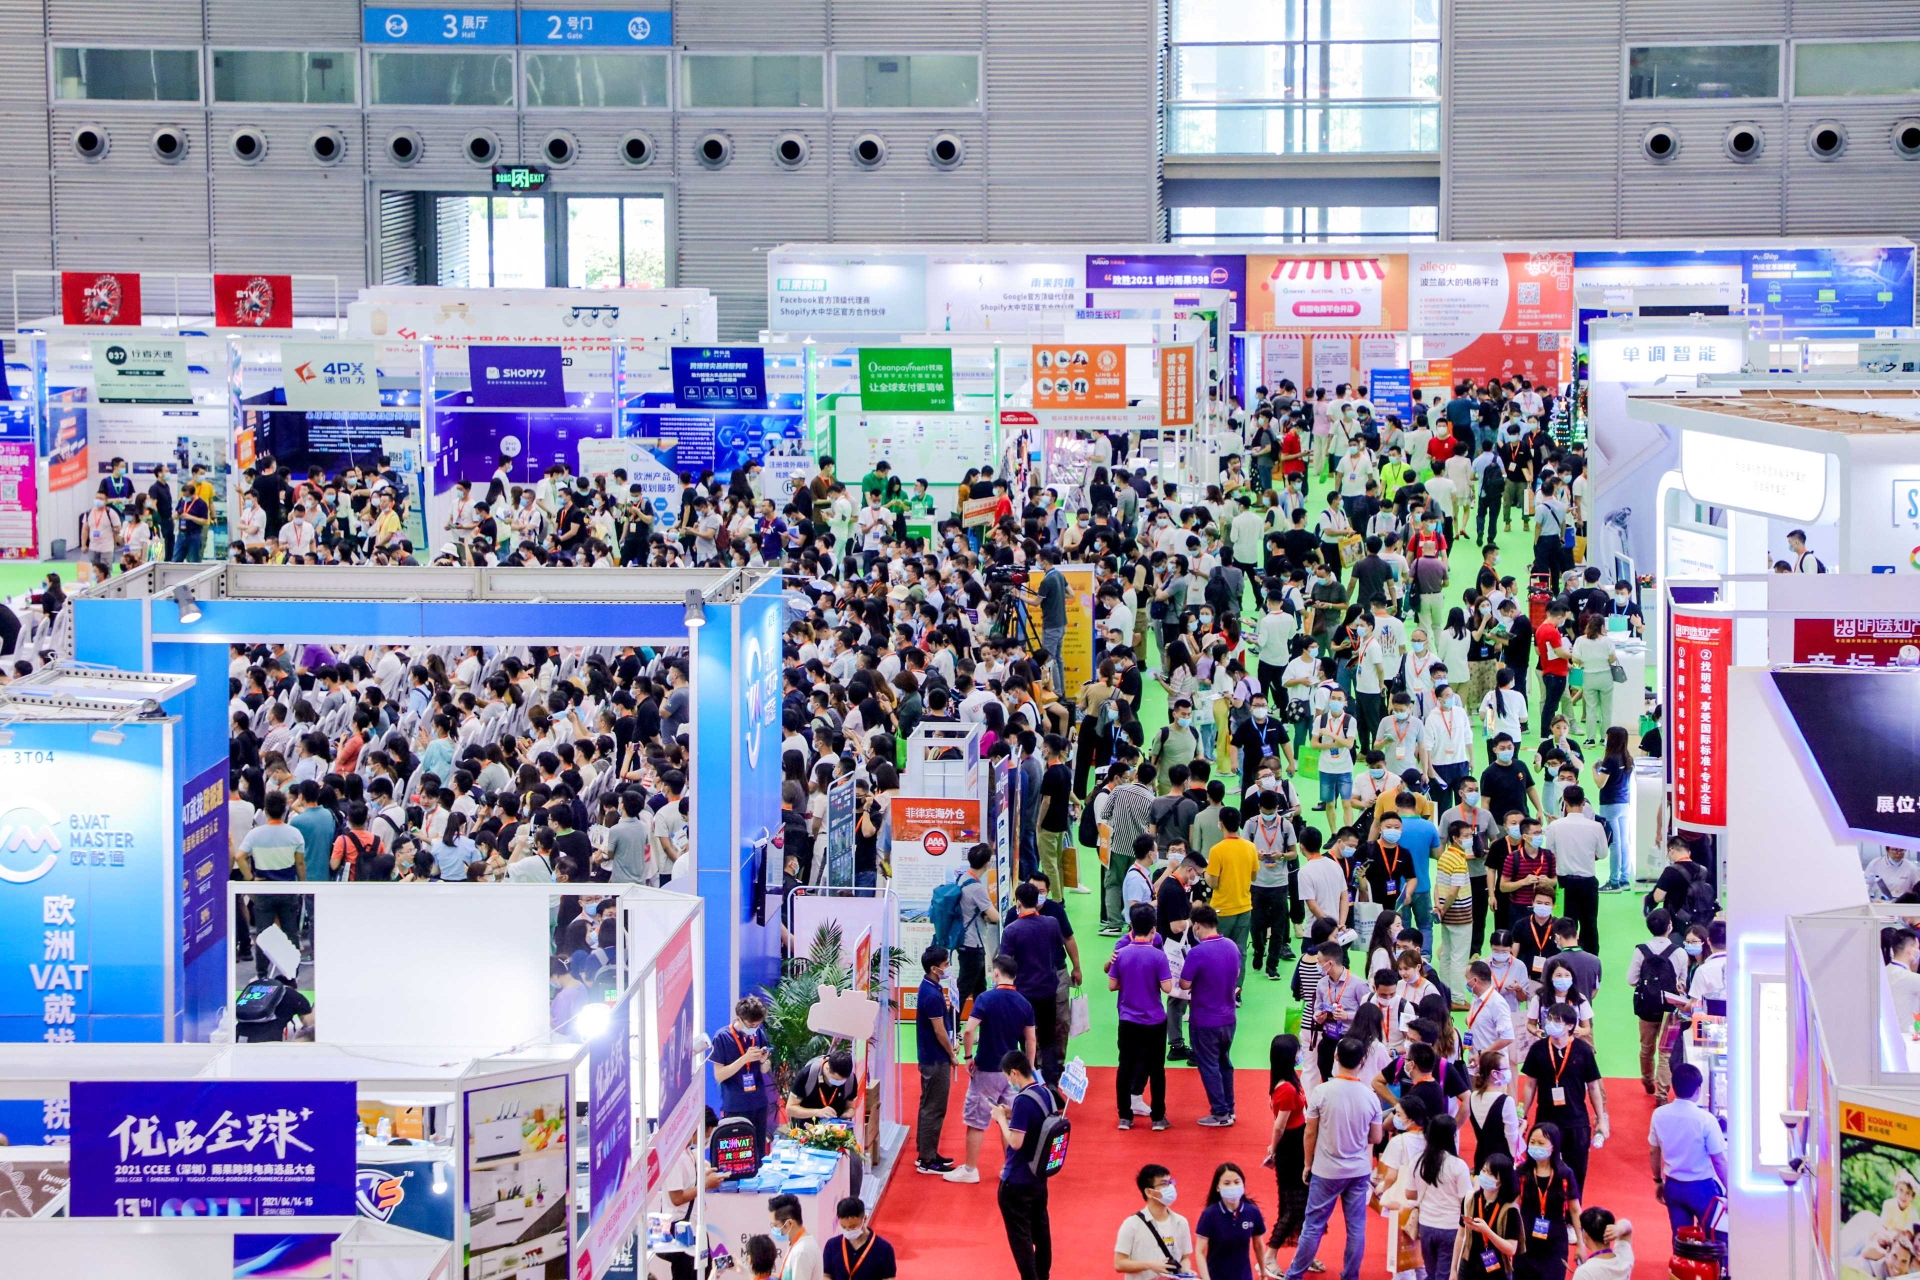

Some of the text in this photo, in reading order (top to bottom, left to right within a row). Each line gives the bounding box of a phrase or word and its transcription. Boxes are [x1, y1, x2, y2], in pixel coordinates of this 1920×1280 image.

[443, 14, 488, 38] 3 展厅
[547, 15, 593, 39] 2 号门
[530, 174, 545, 182] EXIT
[1420, 261, 1457, 273] allegro
[1031, 278, 1075, 287] 雨果跨境
[1420, 277, 1499, 287] 波兰最大的电商平台
[780, 296, 870, 304] Facebook官方顶级代理商
[780, 308, 886, 316] Shopify大中华区官方合作伙伴
[1622, 346, 1716, 361] 单调智能
[323, 362, 365, 375] 4PX
[503, 368, 546, 378] SHOPYY
[324, 376, 366, 384] 递四方
[869, 383, 944, 392] 让全球支付更简单
[633, 472, 671, 481] 欧洲产品
[1876, 795, 1920, 813] 展位
[906, 807, 965, 820] 菲律宾海外仓
[70, 832, 134, 848] MASTER
[926, 837, 945, 847] AAA
[70, 850, 125, 867] 欧税通
[1868, 1115, 1893, 1128] KODAK
[719, 1138, 750, 1149] 欧洲VAT
[114, 1165, 141, 1175] 2021
[143, 1165, 171, 1175] CCEE
